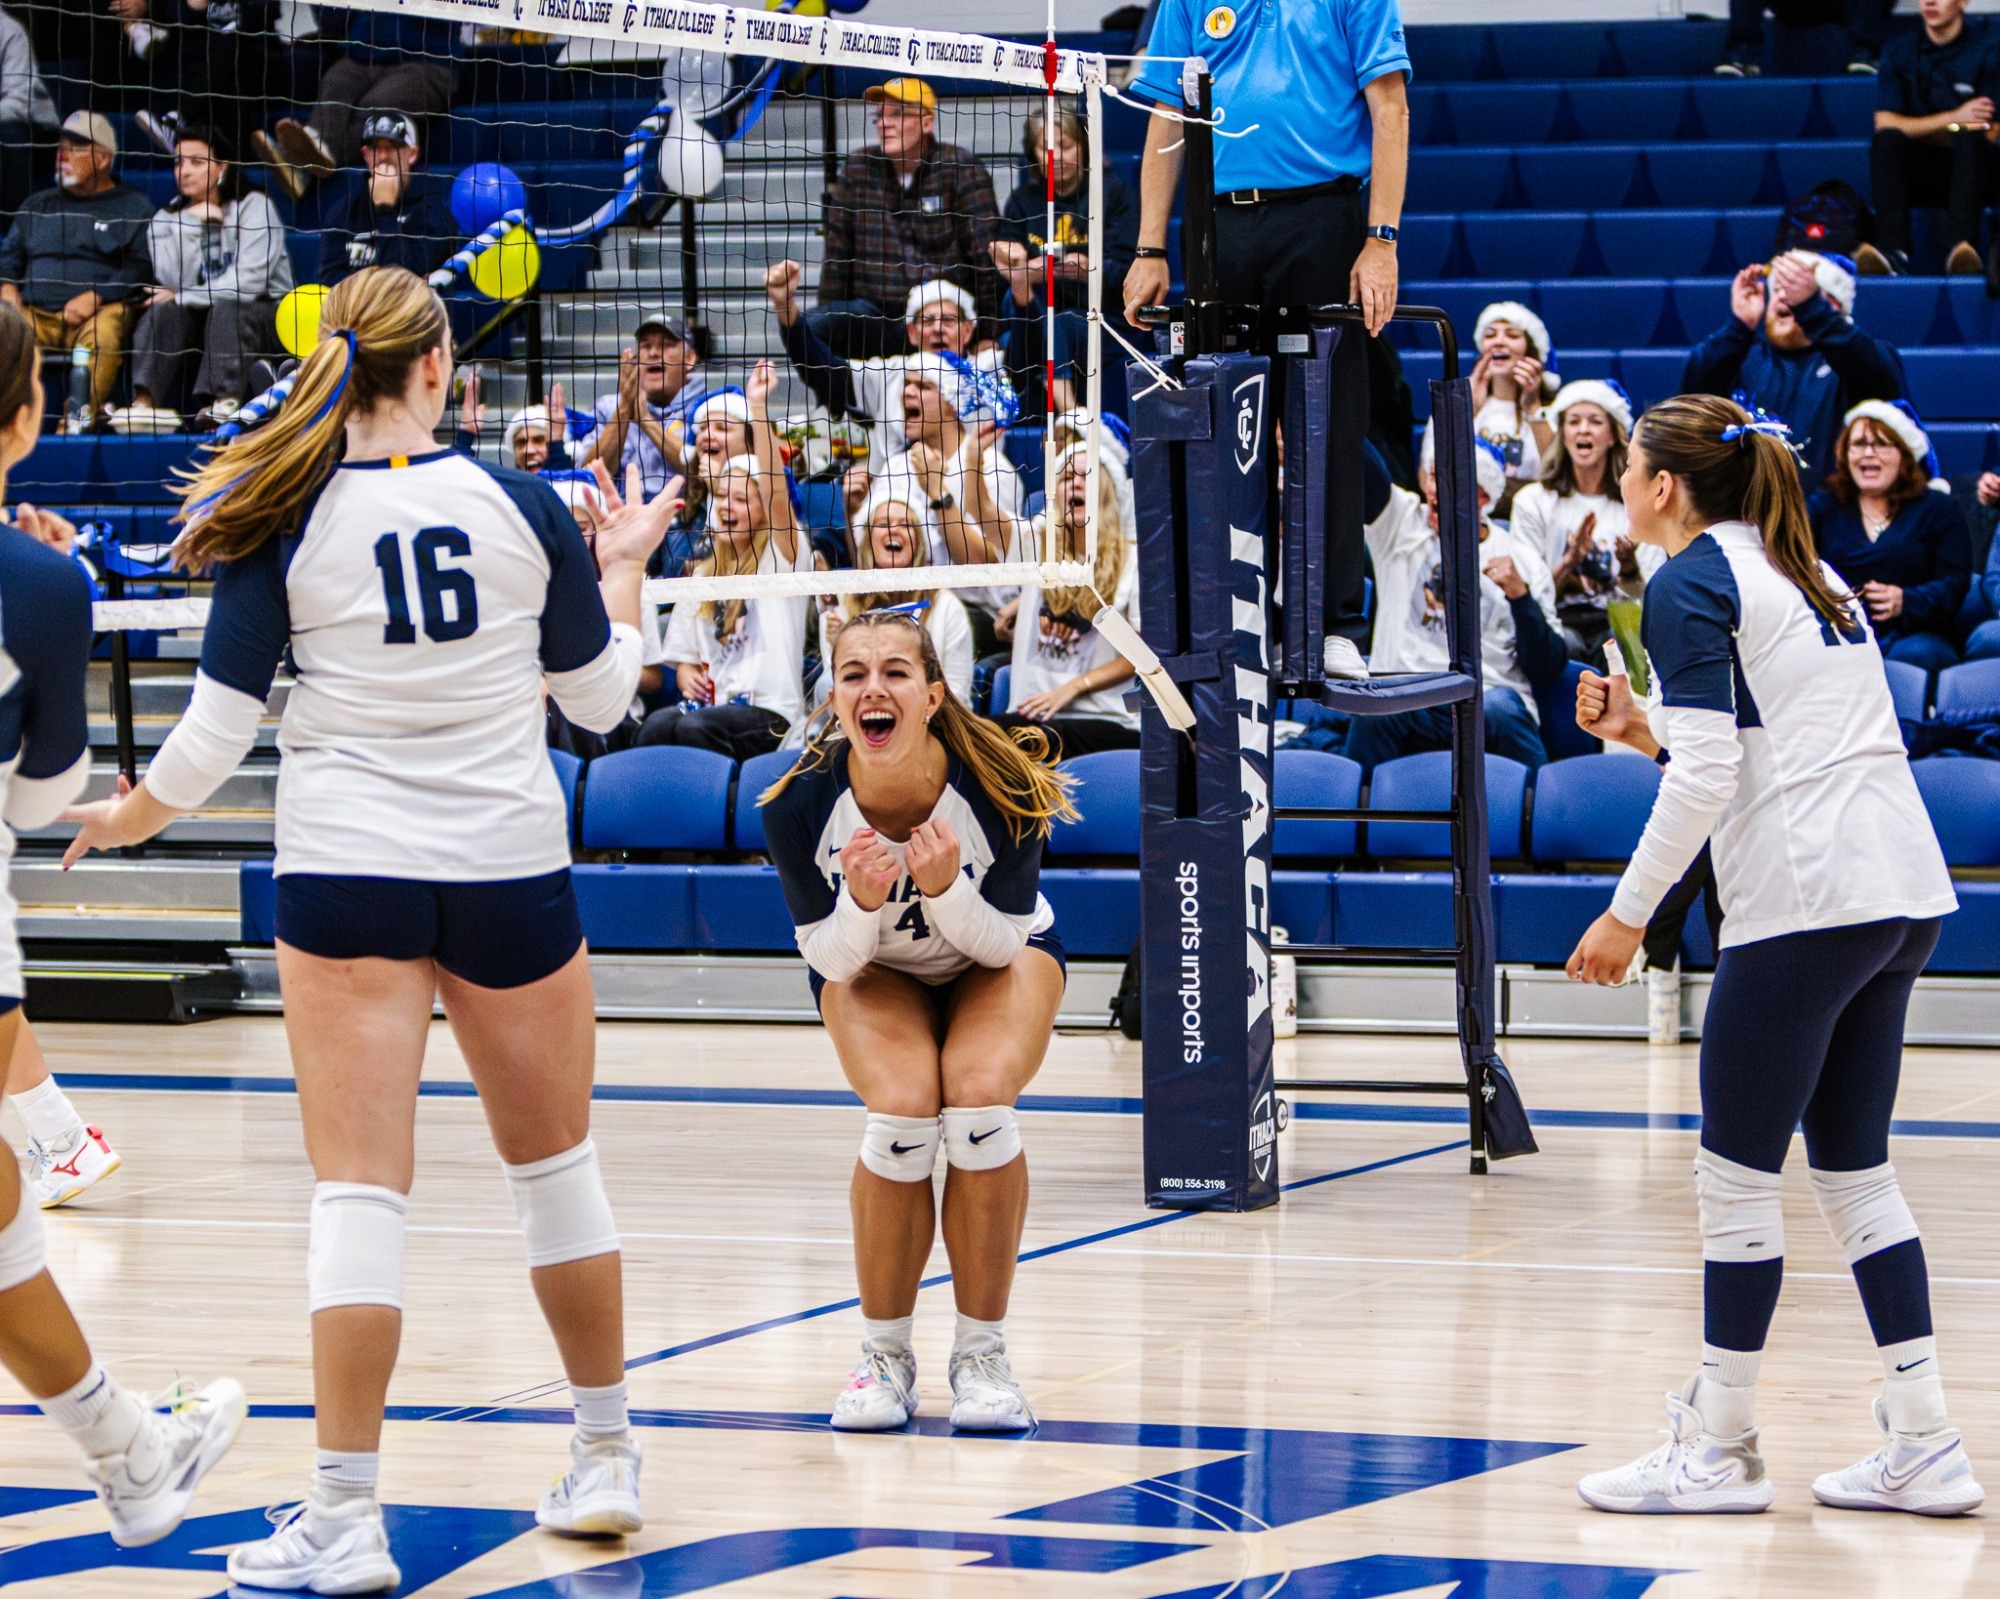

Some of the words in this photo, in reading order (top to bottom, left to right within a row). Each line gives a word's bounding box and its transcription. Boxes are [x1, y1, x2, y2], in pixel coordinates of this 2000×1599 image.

[679, 10, 716, 35] CLLEGE
[746, 19, 776, 41] THACA
[373, 525, 479, 645] 16
[1230, 523, 1270, 1034] ITHACA
[894, 900, 931, 941] 4
[1175, 861, 1203, 950] sports
[1178, 955, 1205, 1064] imports
[1248, 1117, 1276, 1152] ITHACA
[1160, 1177, 1184, 1189] (800)
[1184, 1178, 1226, 1190] 556-3198
